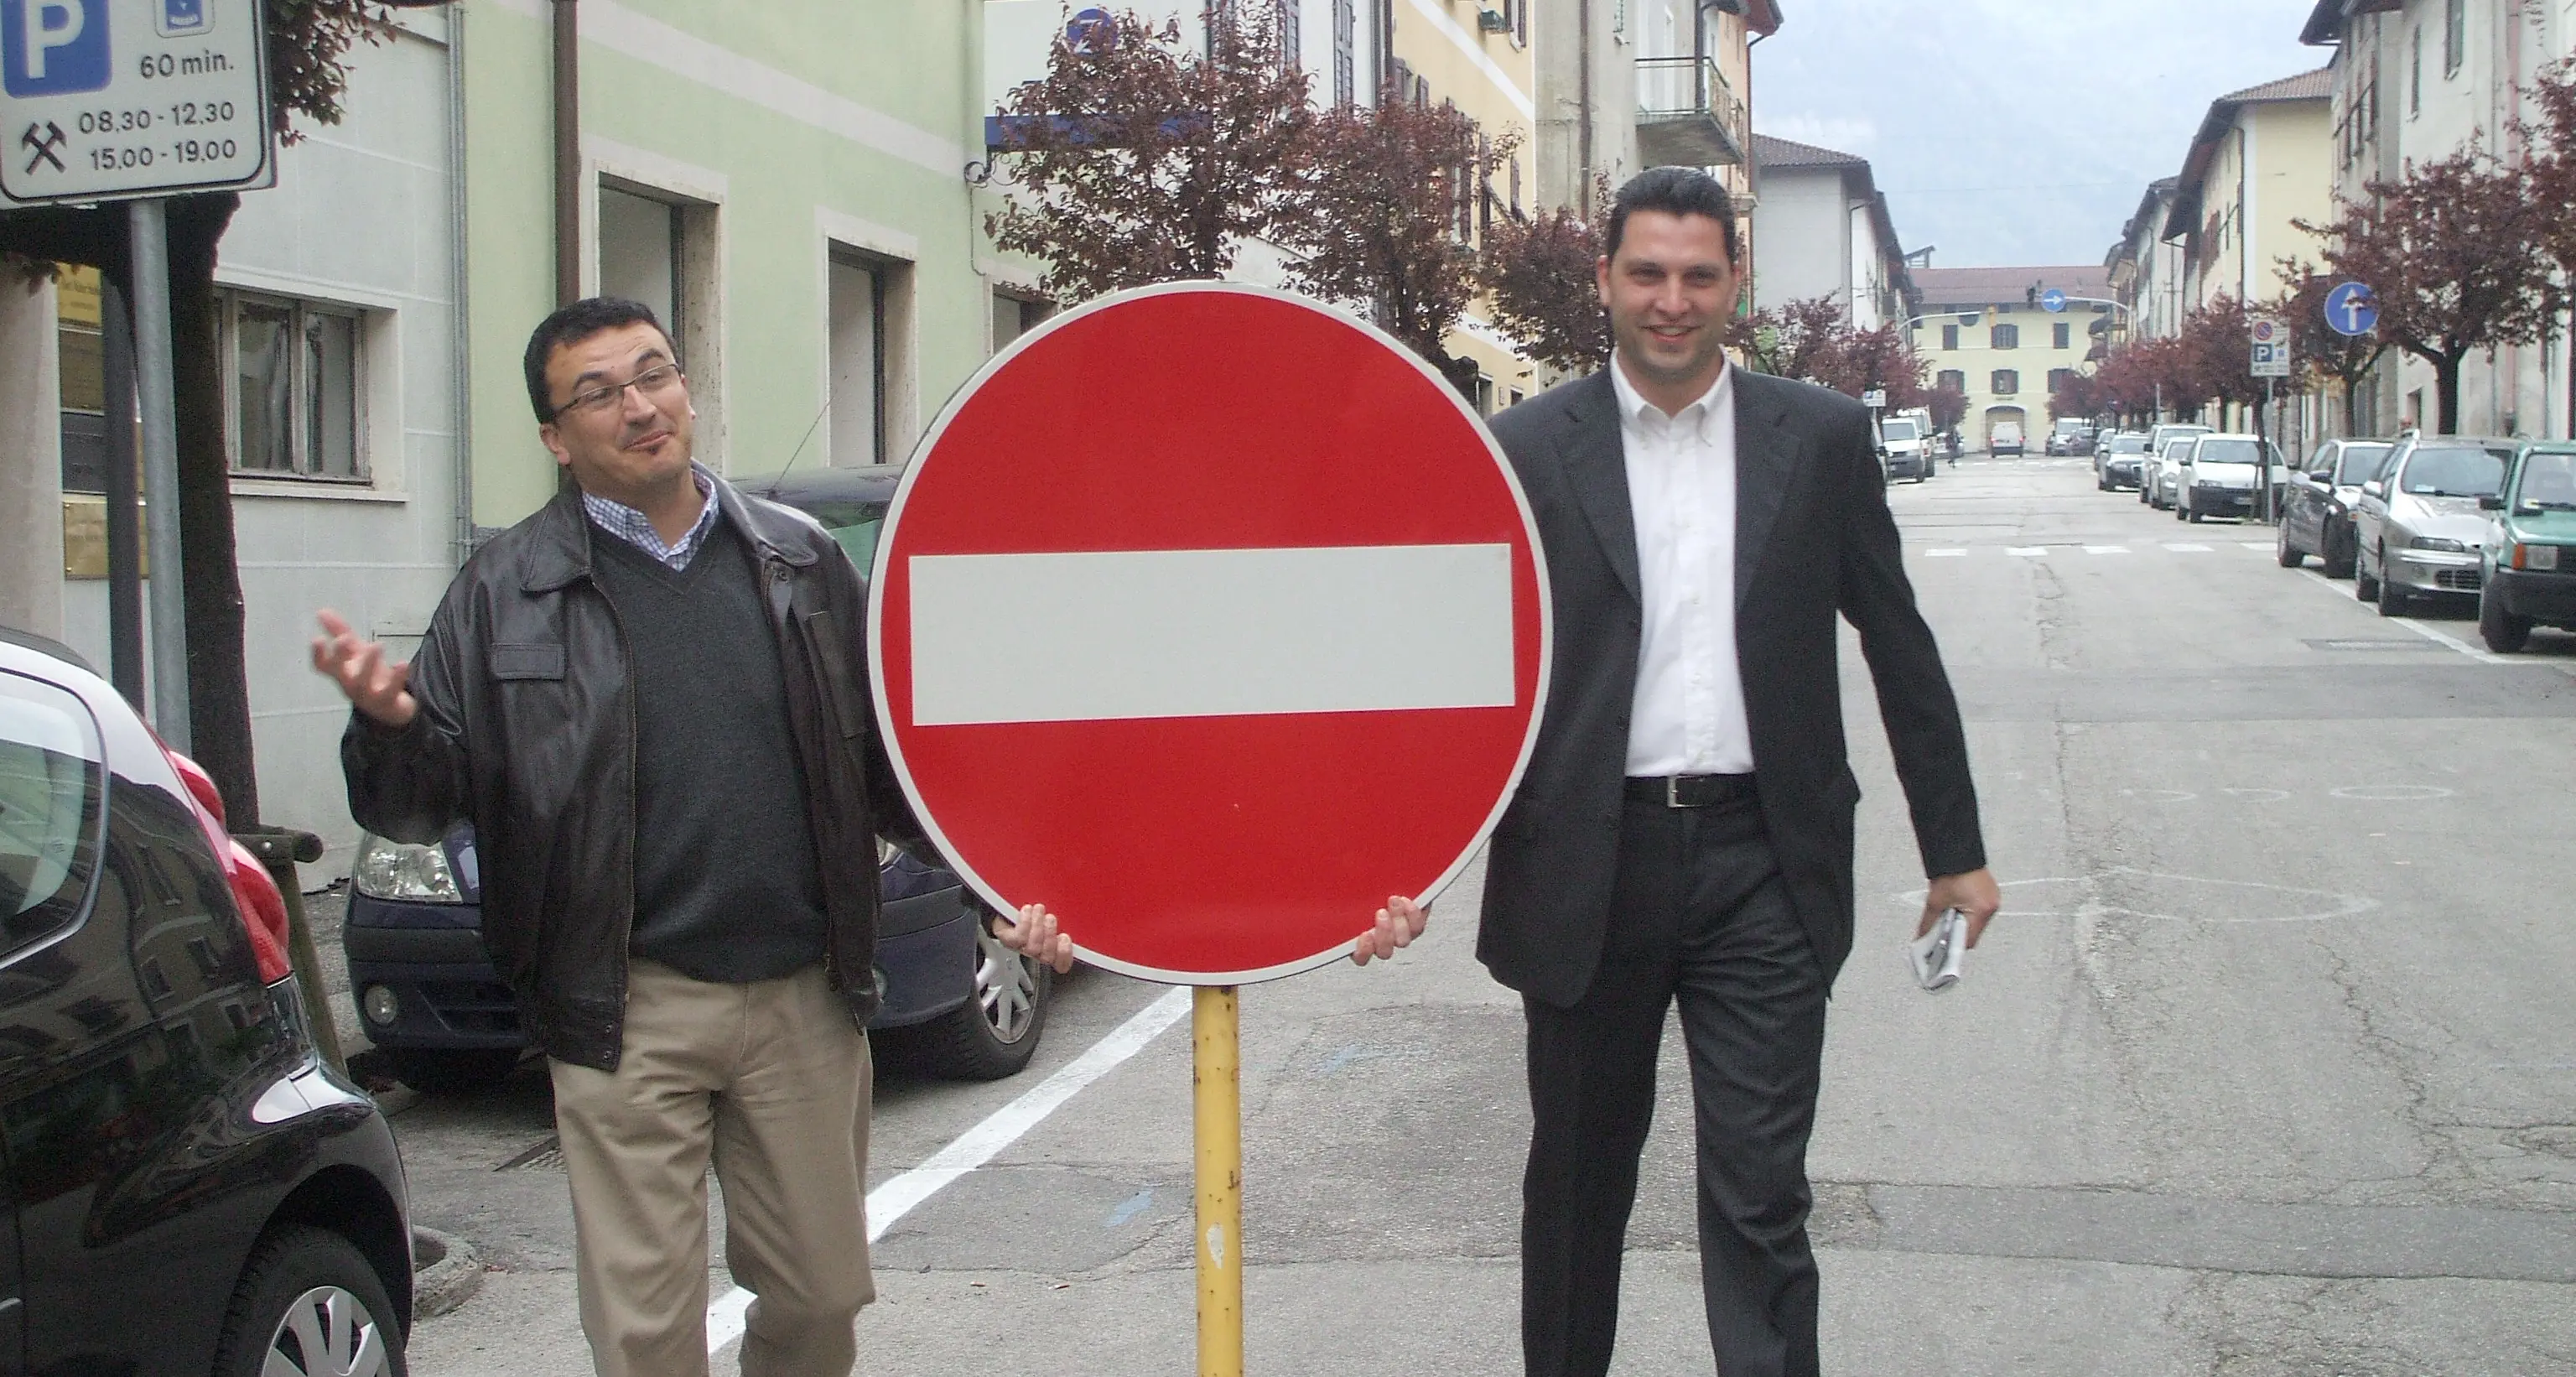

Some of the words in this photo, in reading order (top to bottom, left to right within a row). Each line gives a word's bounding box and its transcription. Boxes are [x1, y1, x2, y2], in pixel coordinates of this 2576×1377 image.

[24, 0, 84, 79] P
[140, 54, 174, 79] 60
[182, 49, 234, 75] min.
[2257, 346, 2269, 361] P
